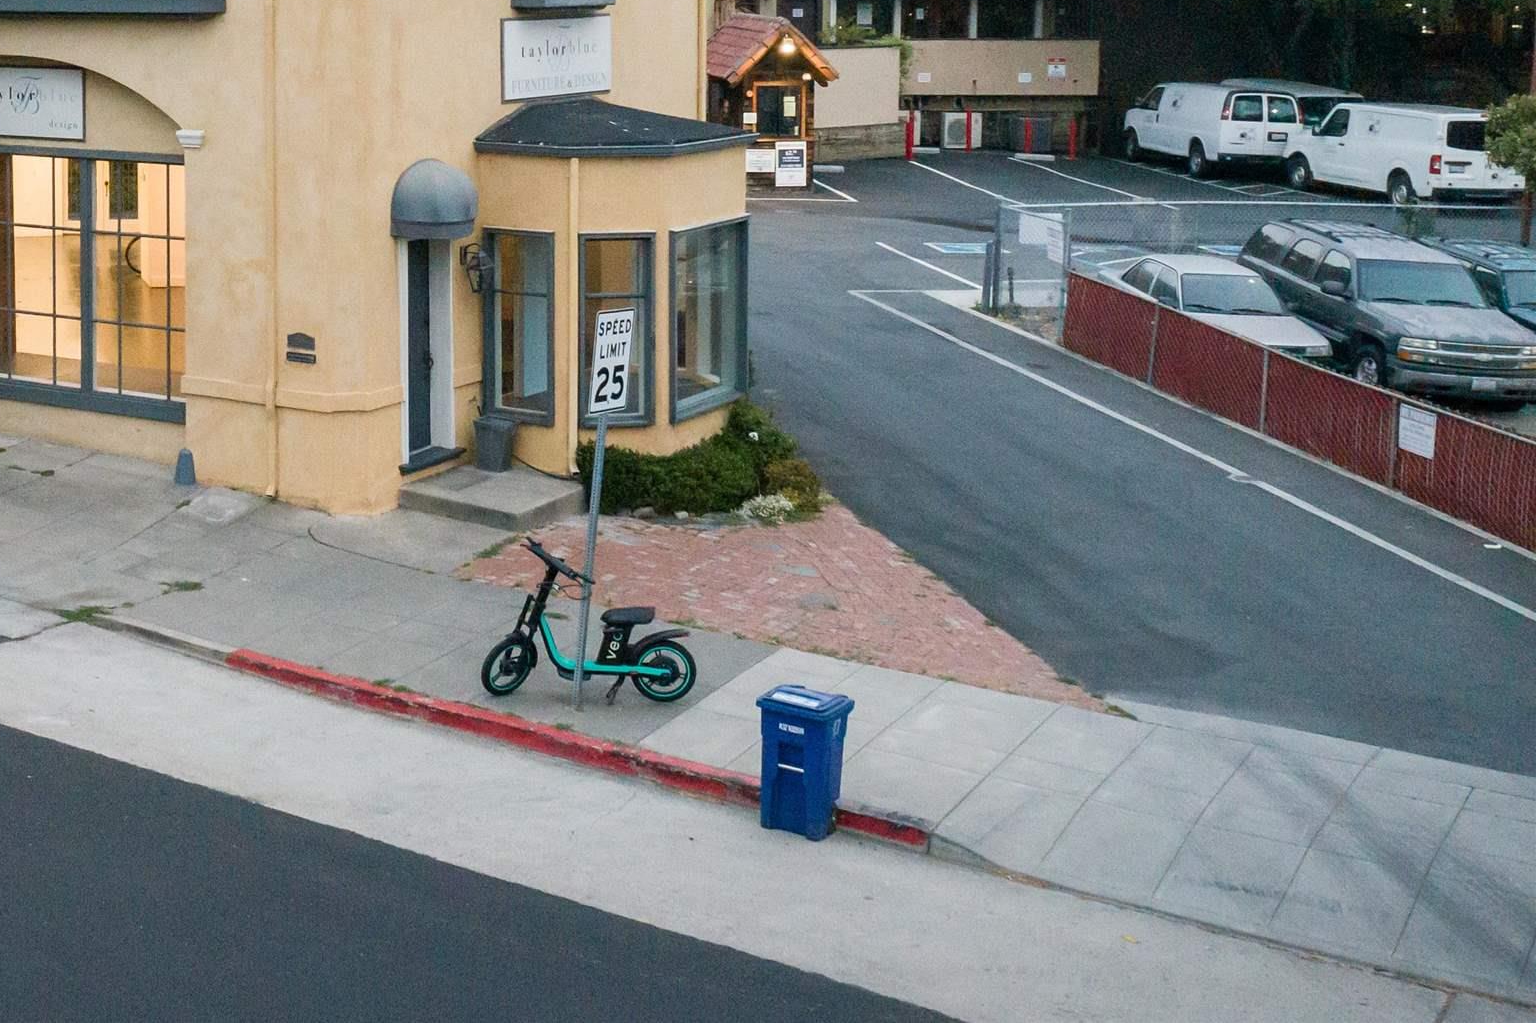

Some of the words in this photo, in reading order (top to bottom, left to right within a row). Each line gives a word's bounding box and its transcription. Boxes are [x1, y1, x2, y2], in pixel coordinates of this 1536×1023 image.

[48, 119, 78, 131] design
[598, 318, 632, 337] SPEED
[599, 341, 627, 359] LIMIT
[594, 364, 625, 403] 25
